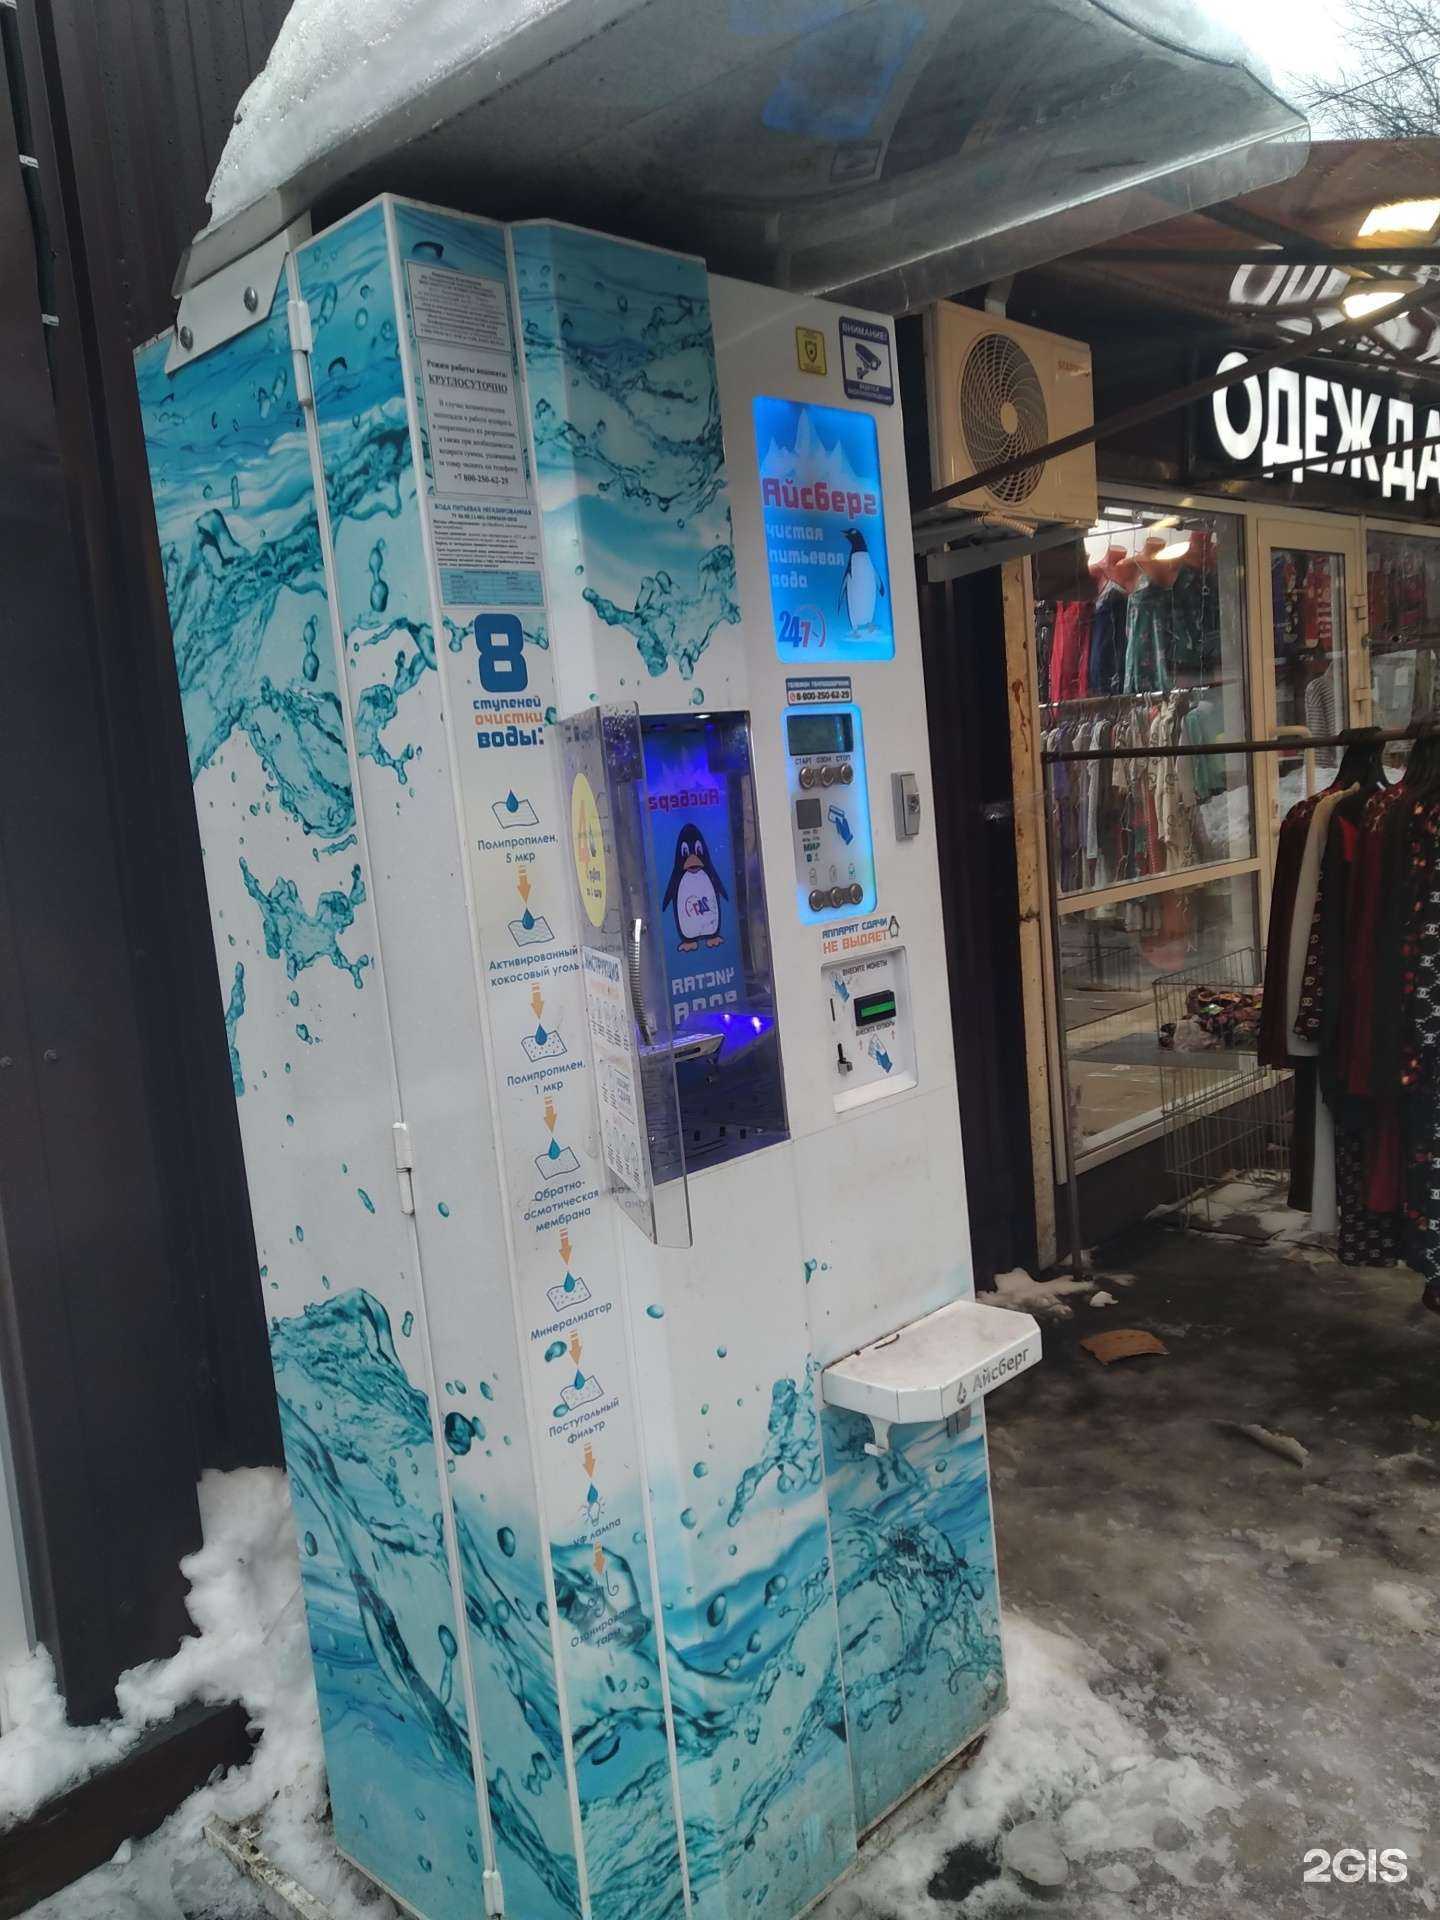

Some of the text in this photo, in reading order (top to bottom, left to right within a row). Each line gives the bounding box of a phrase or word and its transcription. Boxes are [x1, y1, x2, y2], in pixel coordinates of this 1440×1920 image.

[762, 478, 877, 520] Айсберг
[766, 523, 823, 541] чистая
[769, 549, 844, 566] питьевая
[771, 571, 808, 588] вода
[474, 613, 528, 693] 8
[473, 696, 541, 712] ступеней
[475, 712, 543, 726] очистки
[477, 725, 544, 748] воды:
[506, 852, 536, 863] 5 мкр
[822, 917, 888, 939] АППАРАТ СДАЧИ
[823, 929, 888, 954] НЕ ВЫДАЕТ
[489, 944, 578, 971] Активированный
[491, 963, 579, 987] кокосовый уголь
[535, 1081, 563, 1094] 1 мкр
[524, 1190, 599, 1221] осмотическая
[536, 1208, 591, 1232] мембрана
[530, 1302, 612, 1340] Минерализатор
[973, 1348, 1029, 1392] Айсберг
[549, 1397, 619, 1437] Постугольный
[567, 1420, 606, 1444] фильтр
[591, 1518, 621, 1541] лампа
